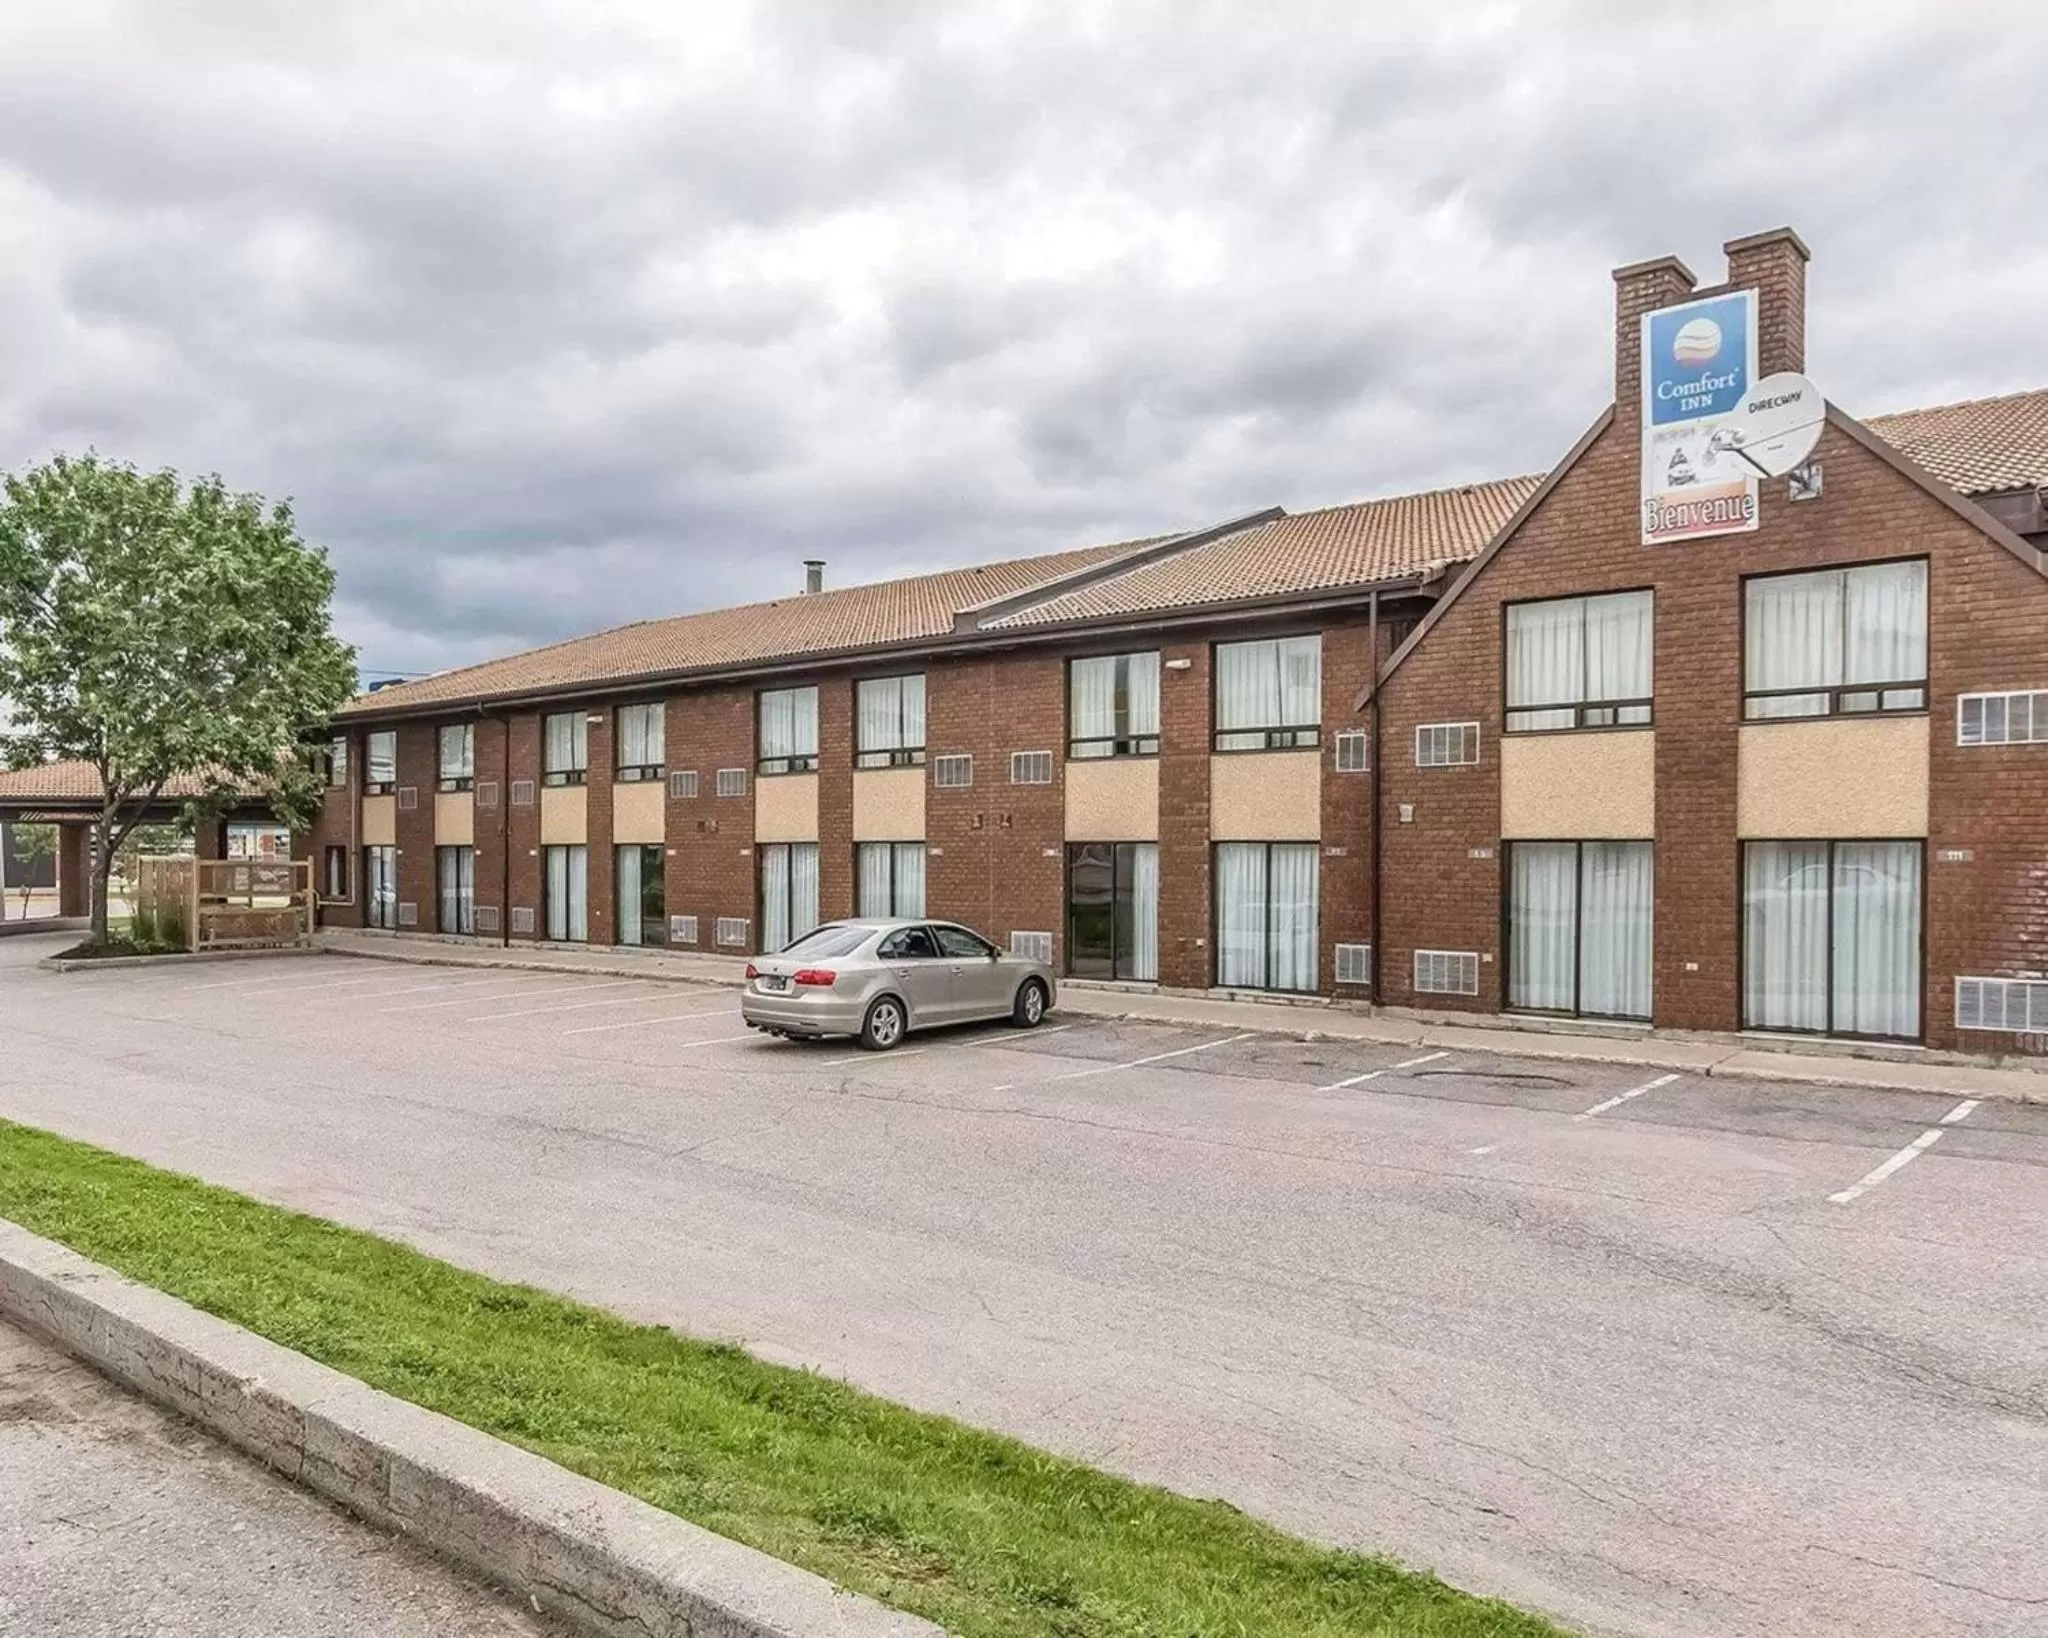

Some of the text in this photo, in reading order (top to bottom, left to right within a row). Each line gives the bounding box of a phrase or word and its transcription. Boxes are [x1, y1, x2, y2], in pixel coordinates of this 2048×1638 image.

[1657, 371, 1736, 399] Comfort
[1680, 393, 1713, 411] INN
[1748, 390, 1802, 413] DIRECWAY
[1645, 494, 1755, 534] Bienvenue
